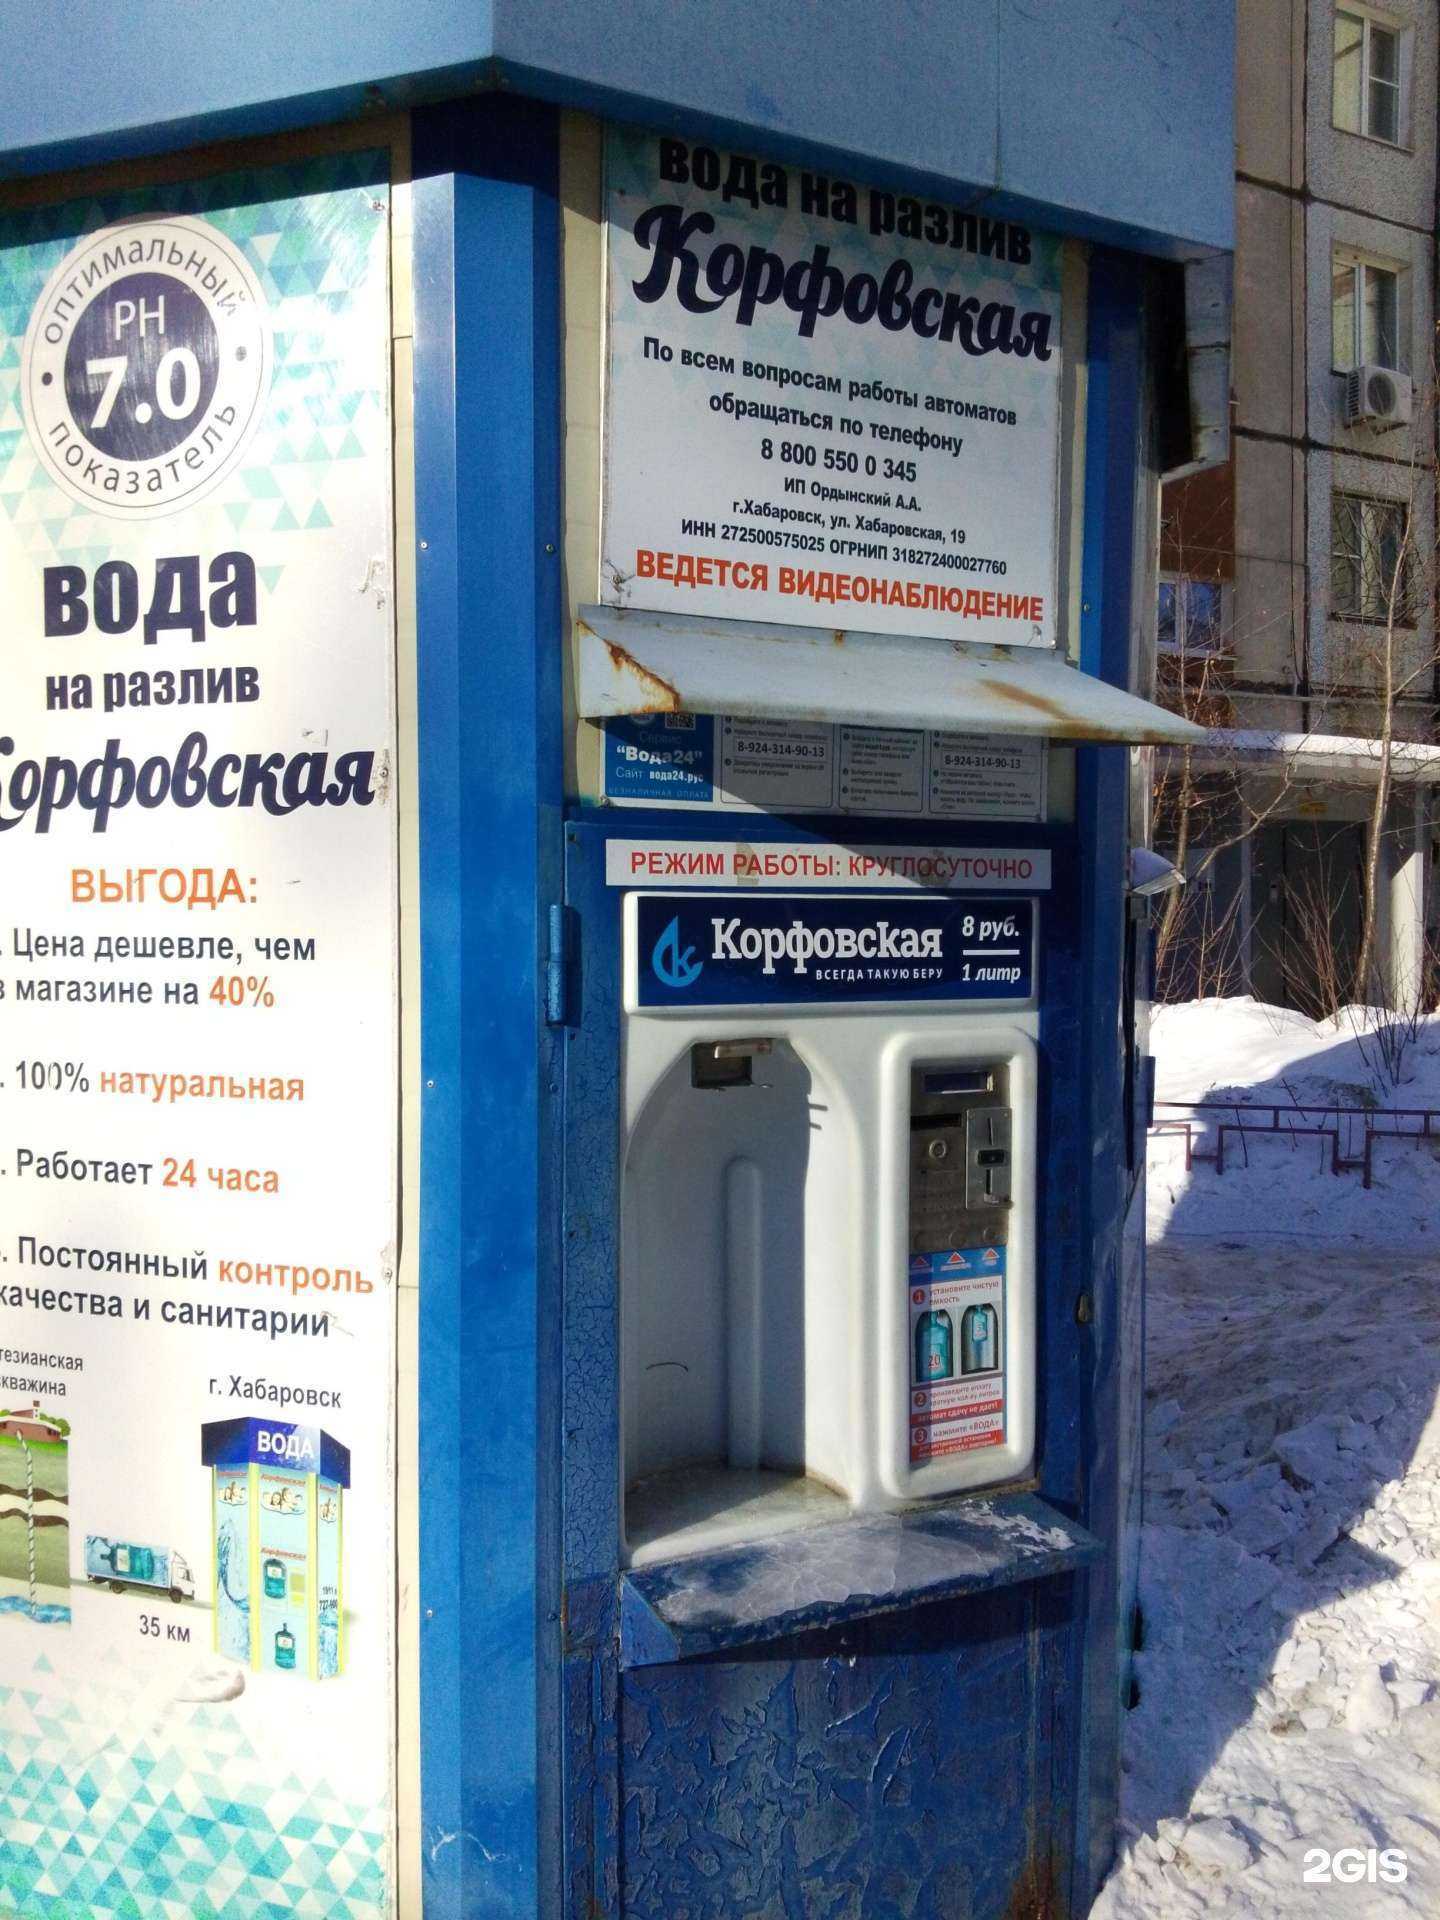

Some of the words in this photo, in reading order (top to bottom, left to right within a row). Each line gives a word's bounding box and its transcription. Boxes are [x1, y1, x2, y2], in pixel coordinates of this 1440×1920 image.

[660, 138, 788, 210] вода
[801, 172, 858, 225] на
[869, 188, 1032, 265] разлив
[633, 204, 1052, 362] Корфовская
[86, 347, 201, 428] 7.0
[643, 336, 673, 363] По
[681, 349, 735, 374] всем
[742, 360, 842, 394] вопросам
[848, 380, 918, 408] работы
[925, 394, 1017, 426] автоматов
[709, 392, 833, 431] обращаться
[840, 417, 863, 436] по
[869, 421, 964, 458] телефону
[48, 402, 238, 495] показатель
[761, 438, 773, 460] 8
[780, 441, 817, 467] 800
[823, 448, 859, 474] 550
[865, 455, 877, 476] 0
[883, 458, 917, 482] 345
[784, 476, 806, 494] ИП
[811, 481, 891, 506] Ордынский
[895, 494, 922, 512] А.А.
[733, 499, 826, 529] г.Хабаровск,
[830, 515, 851, 530] ул.
[855, 515, 946, 545] Хабаровская,
[951, 529, 966, 544] 19
[681, 519, 716, 538] ИНН
[721, 524, 825, 552] 272500575025
[830, 539, 888, 561] ОГРНИП
[892, 547, 1007, 576] 318272400027760
[43, 551, 258, 645] вода
[636, 549, 769, 592] ВЕДЕТСЯ
[778, 566, 1044, 622] ВИДЕОНАБЛЮДЕНИЕ
[45, 673, 93, 711] на
[103, 666, 261, 713] разлив
[737, 741, 825, 758] 8-924-314-90-13
[944, 754, 1021, 769] 8-924-314-90-13
[615, 767, 643, 779] Сайт
[631, 852, 725, 875] РЕЖИМ
[733, 854, 840, 876] РАБОТЫ:
[850, 855, 1033, 879] КРУГЛОСУТОЧНО
[71, 868, 257, 911] ВЫГОДА:
[13, 927, 85, 962] Цена
[94, 934, 244, 966] дешевле,
[254, 936, 317, 961] чем
[711, 918, 943, 975] Корфовская
[962, 916, 975, 937] 8
[979, 916, 1020, 941] руб.
[16, 978, 153, 1004] магазине
[164, 978, 199, 1005] на
[208, 974, 276, 1009] 40%
[816, 969, 864, 982] ВСЕГДА
[867, 968, 910, 980] ТАКУЮ
[913, 968, 943, 979] БЕРУ
[962, 963, 971, 981] 1
[975, 966, 1021, 984] литр
[15, 1060, 90, 1094] 100%
[100, 1069, 306, 1104] натуральная
[16, 1148, 154, 1186] Работает
[162, 1157, 197, 1188] 24
[208, 1167, 280, 1193] часа
[18, 1236, 209, 1281] Постоянный
[219, 1260, 374, 1295] контроль
[133, 1298, 150, 1321] и
[160, 1299, 329, 1340] санитарии
[209, 1378, 223, 1396] г.
[229, 1375, 342, 1409] Хабаровск
[257, 1430, 315, 1461] ВОДА
[139, 1614, 161, 1637] 35
[166, 1622, 191, 1643] км
